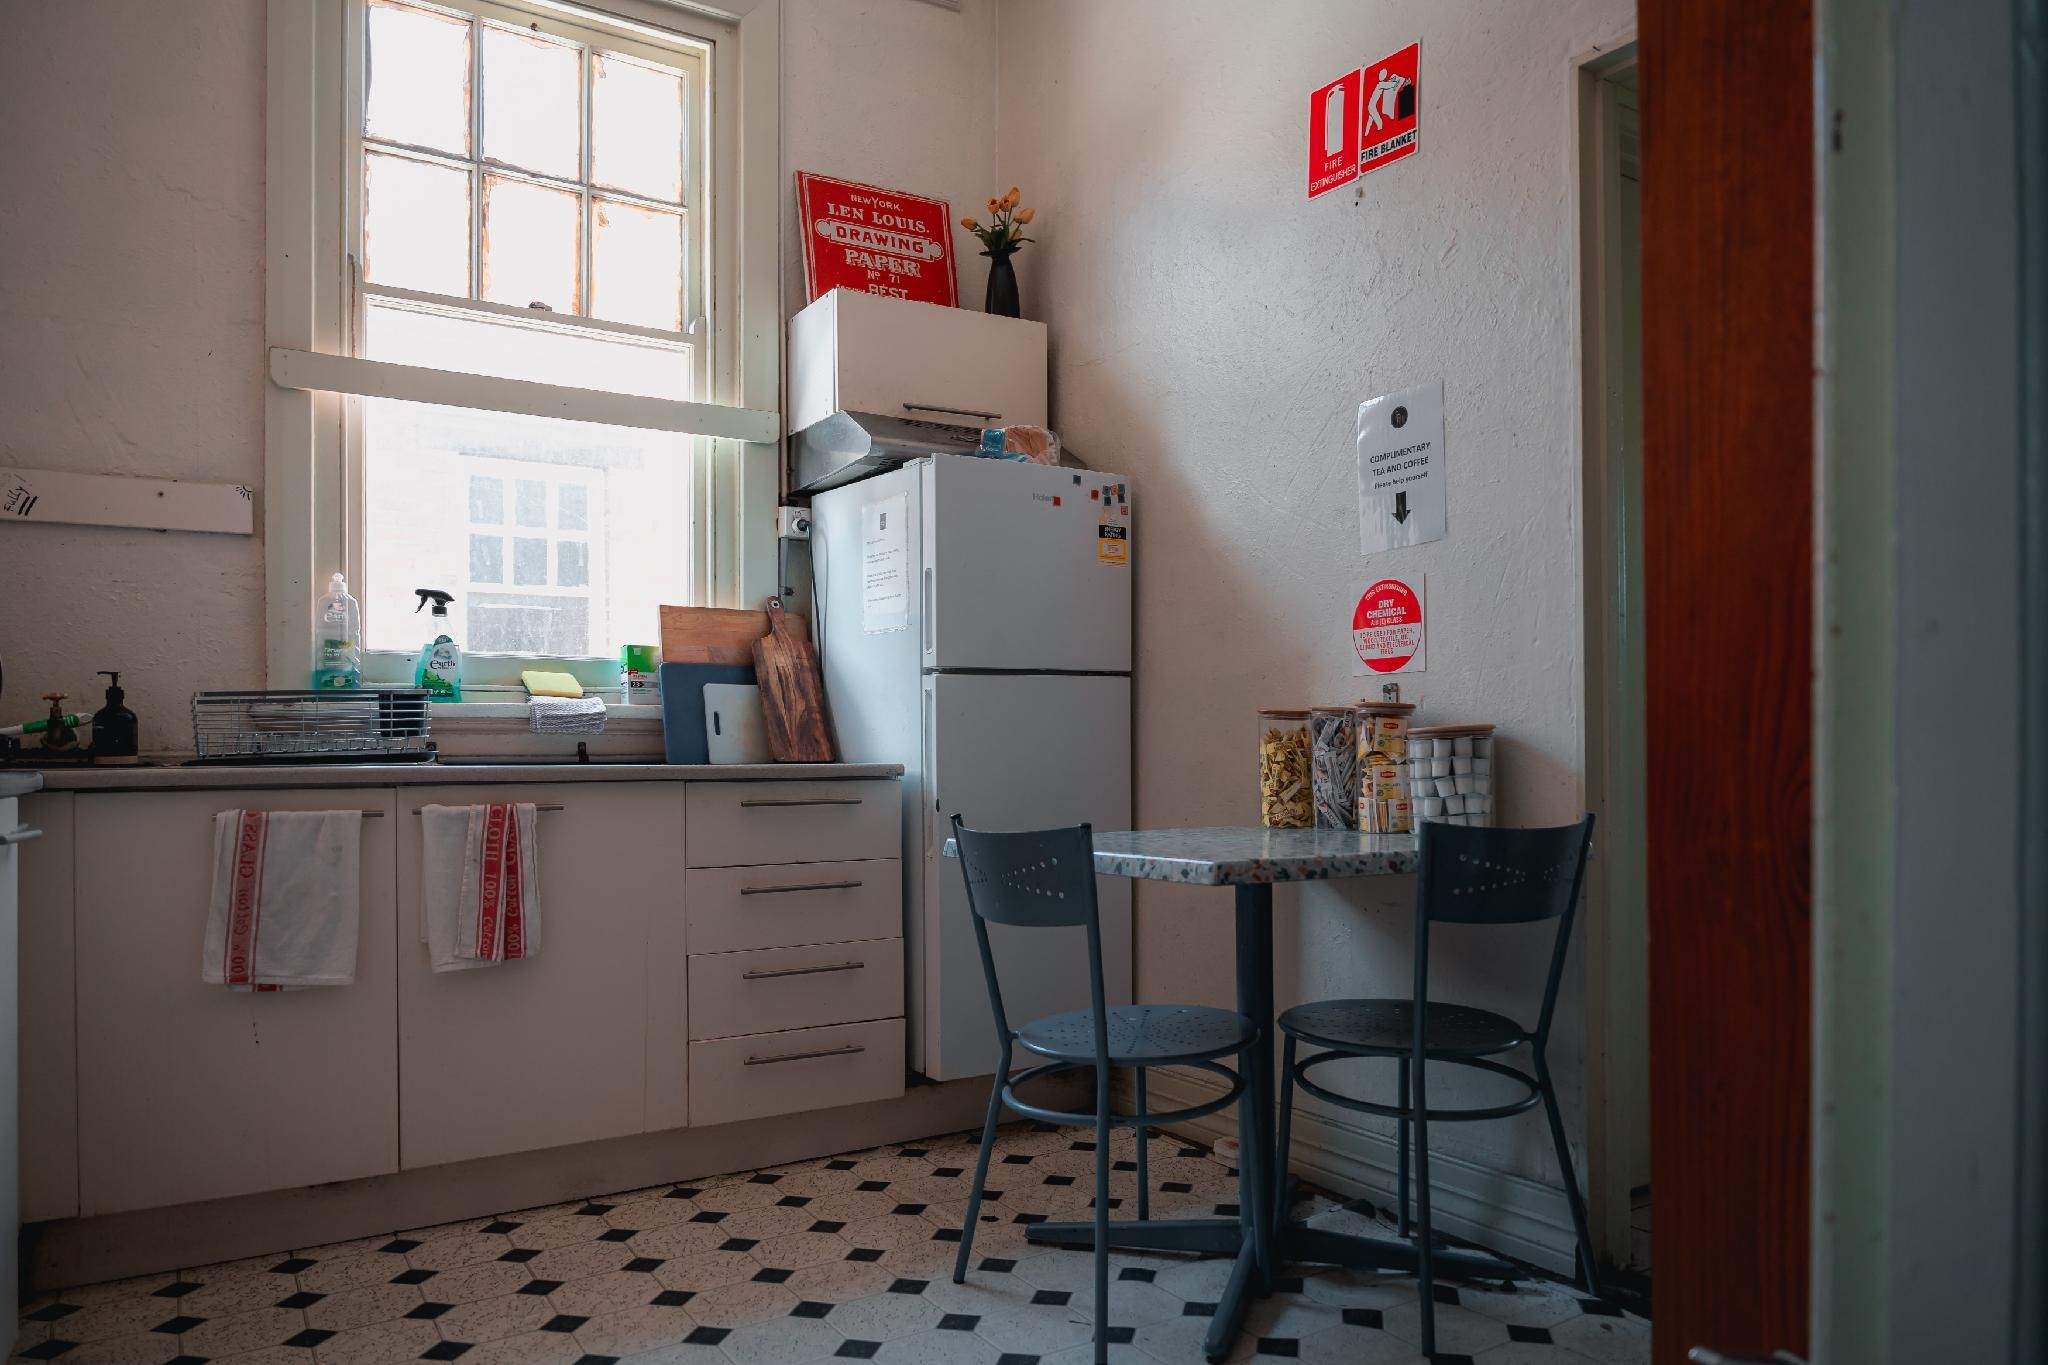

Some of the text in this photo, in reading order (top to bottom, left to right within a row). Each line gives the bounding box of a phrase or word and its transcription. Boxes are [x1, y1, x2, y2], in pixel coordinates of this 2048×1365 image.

[1360, 129, 1418, 162] FIRE BLANKET
[1324, 156, 1343, 171] FIRE
[1310, 164, 1357, 192] EXTINGUISHER
[827, 202, 864, 221] LEN
[836, 225, 924, 253] DRAWING
[844, 248, 922, 278] PAPER
[868, 283, 908, 300] BEST
[1370, 441, 1431, 464] COMPLIMENTARY
[1372, 456, 1429, 477] TEA AND COFFEE
[1374, 471, 1428, 490] Please help yourself
[1366, 606, 1407, 619] CHEMICAL
[1378, 599, 1395, 609] DRY
[486, 805, 505, 862] CLOTH
[485, 873, 498, 908] 100%
[507, 875, 518, 917] Cotton
[507, 923, 521, 959] 100%
